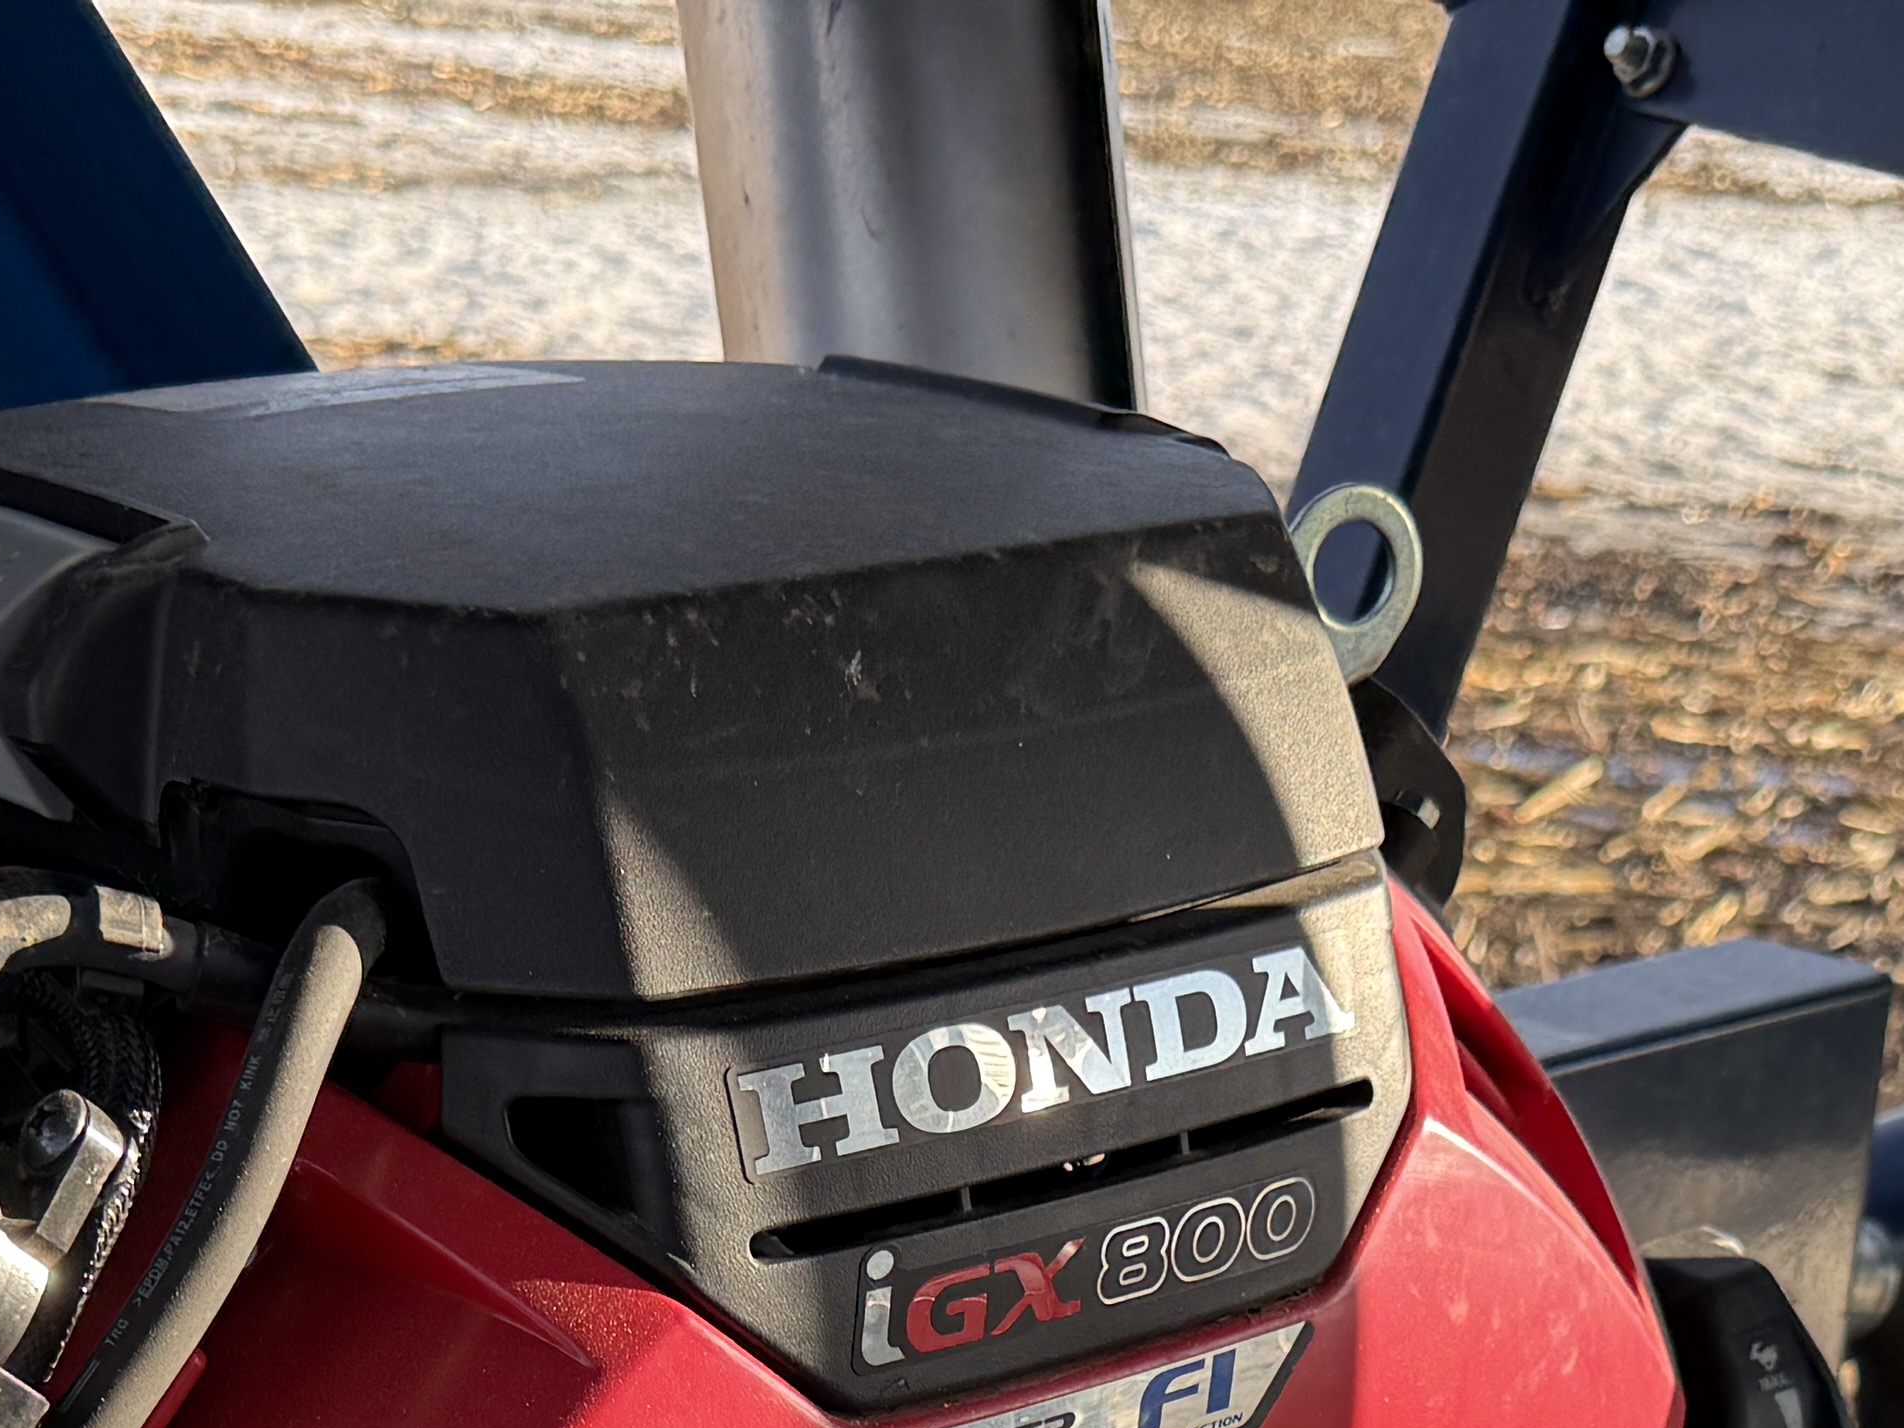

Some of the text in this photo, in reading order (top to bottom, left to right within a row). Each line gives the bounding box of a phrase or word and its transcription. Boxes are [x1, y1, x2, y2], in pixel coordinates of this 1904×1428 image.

[223, 1099, 246, 1133] NOT
[239, 1054, 263, 1090] KINK
[737, 946, 1355, 1177] HONDA
[1097, 1176, 1315, 1306] 800
